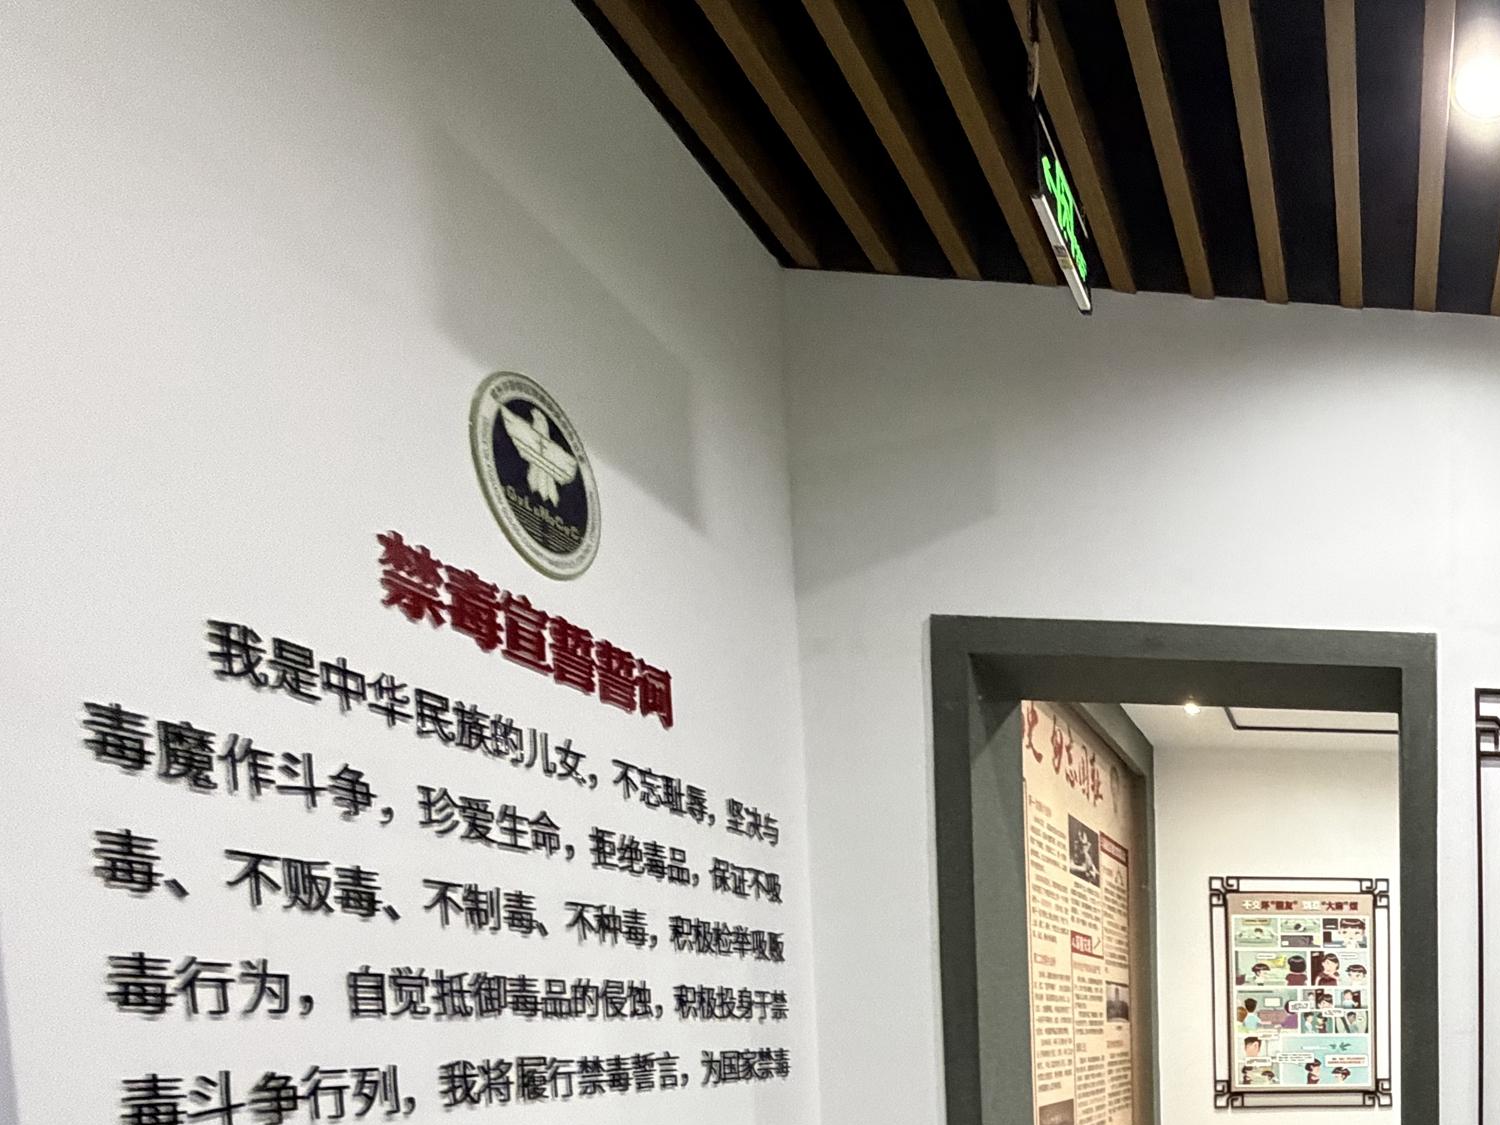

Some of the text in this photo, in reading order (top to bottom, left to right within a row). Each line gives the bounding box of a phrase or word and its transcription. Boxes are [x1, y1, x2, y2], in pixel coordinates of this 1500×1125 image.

[376, 530, 675, 729] 禁毒宣誓誓词
